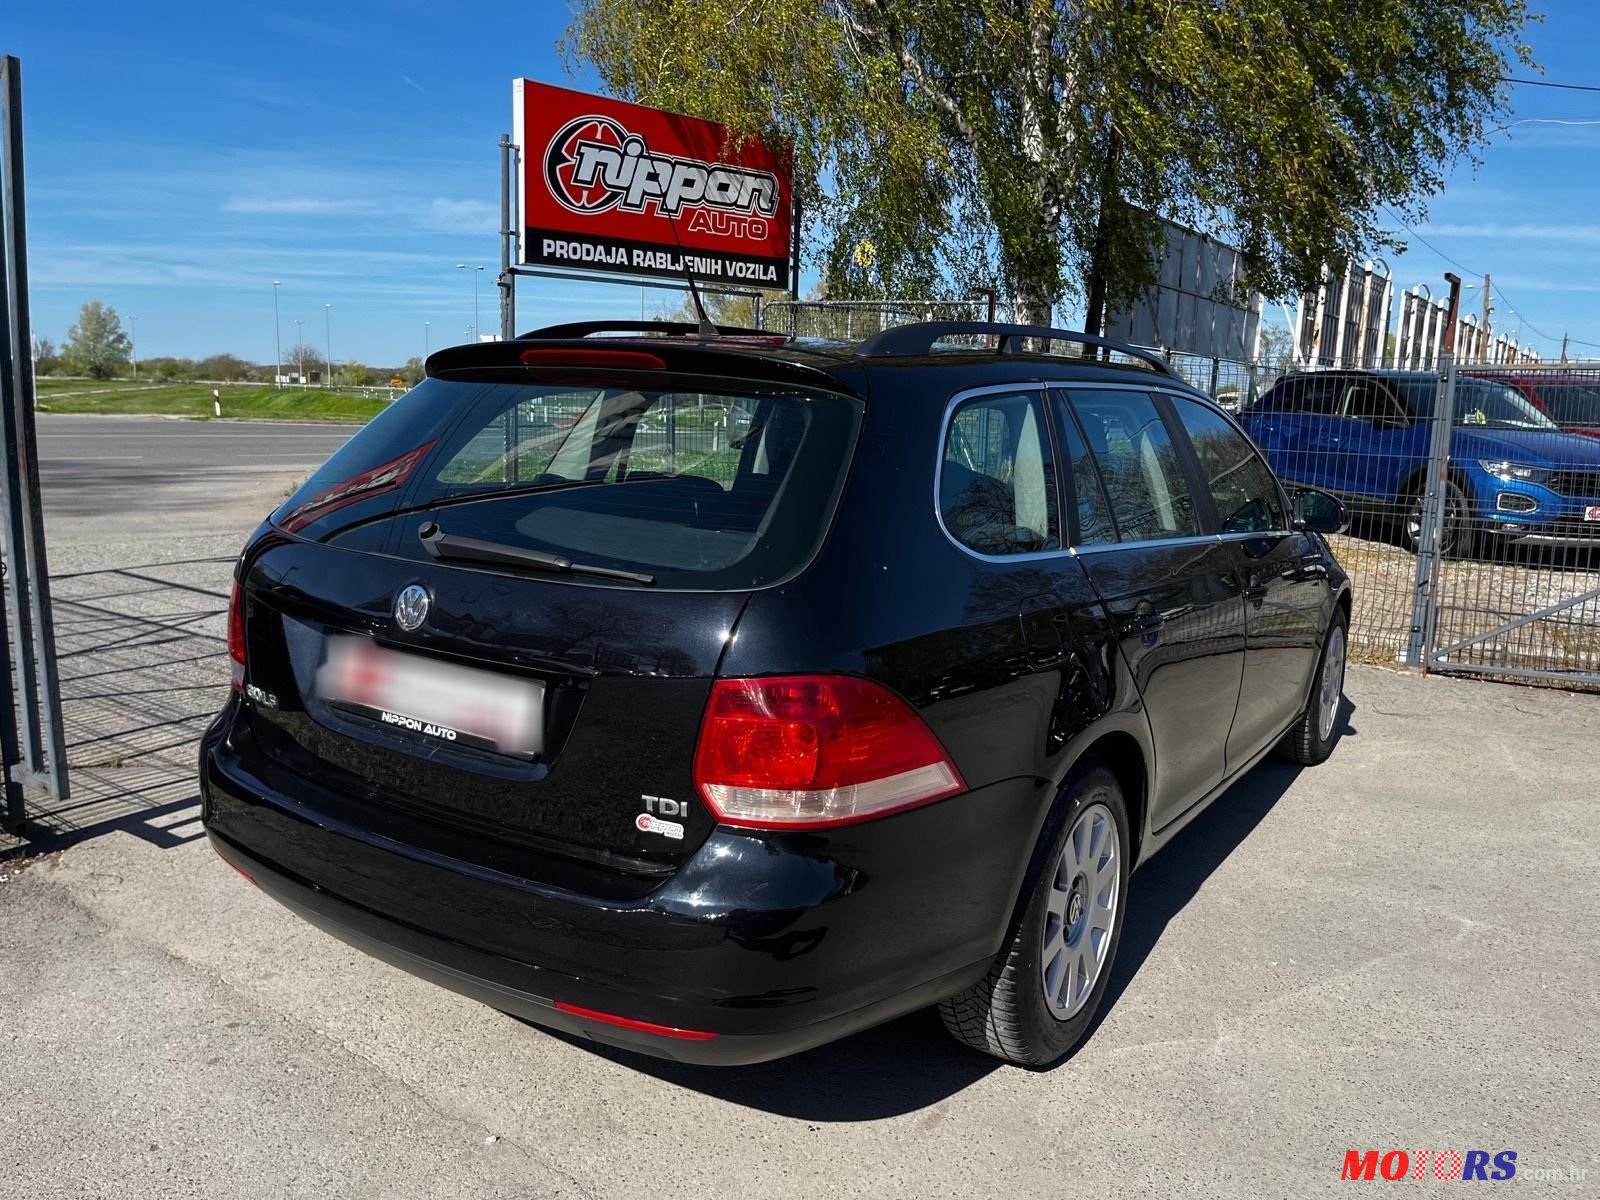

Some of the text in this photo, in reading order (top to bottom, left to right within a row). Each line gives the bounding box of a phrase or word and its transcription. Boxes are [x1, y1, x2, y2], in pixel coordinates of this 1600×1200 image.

[573, 135, 779, 216] nippon
[688, 209, 769, 241] AUTO
[542, 239, 629, 266] PRODAJA
[725, 260, 778, 282] VOZILA
[381, 711, 457, 741] NIPPON AUTO
[641, 794, 688, 817] TDI
